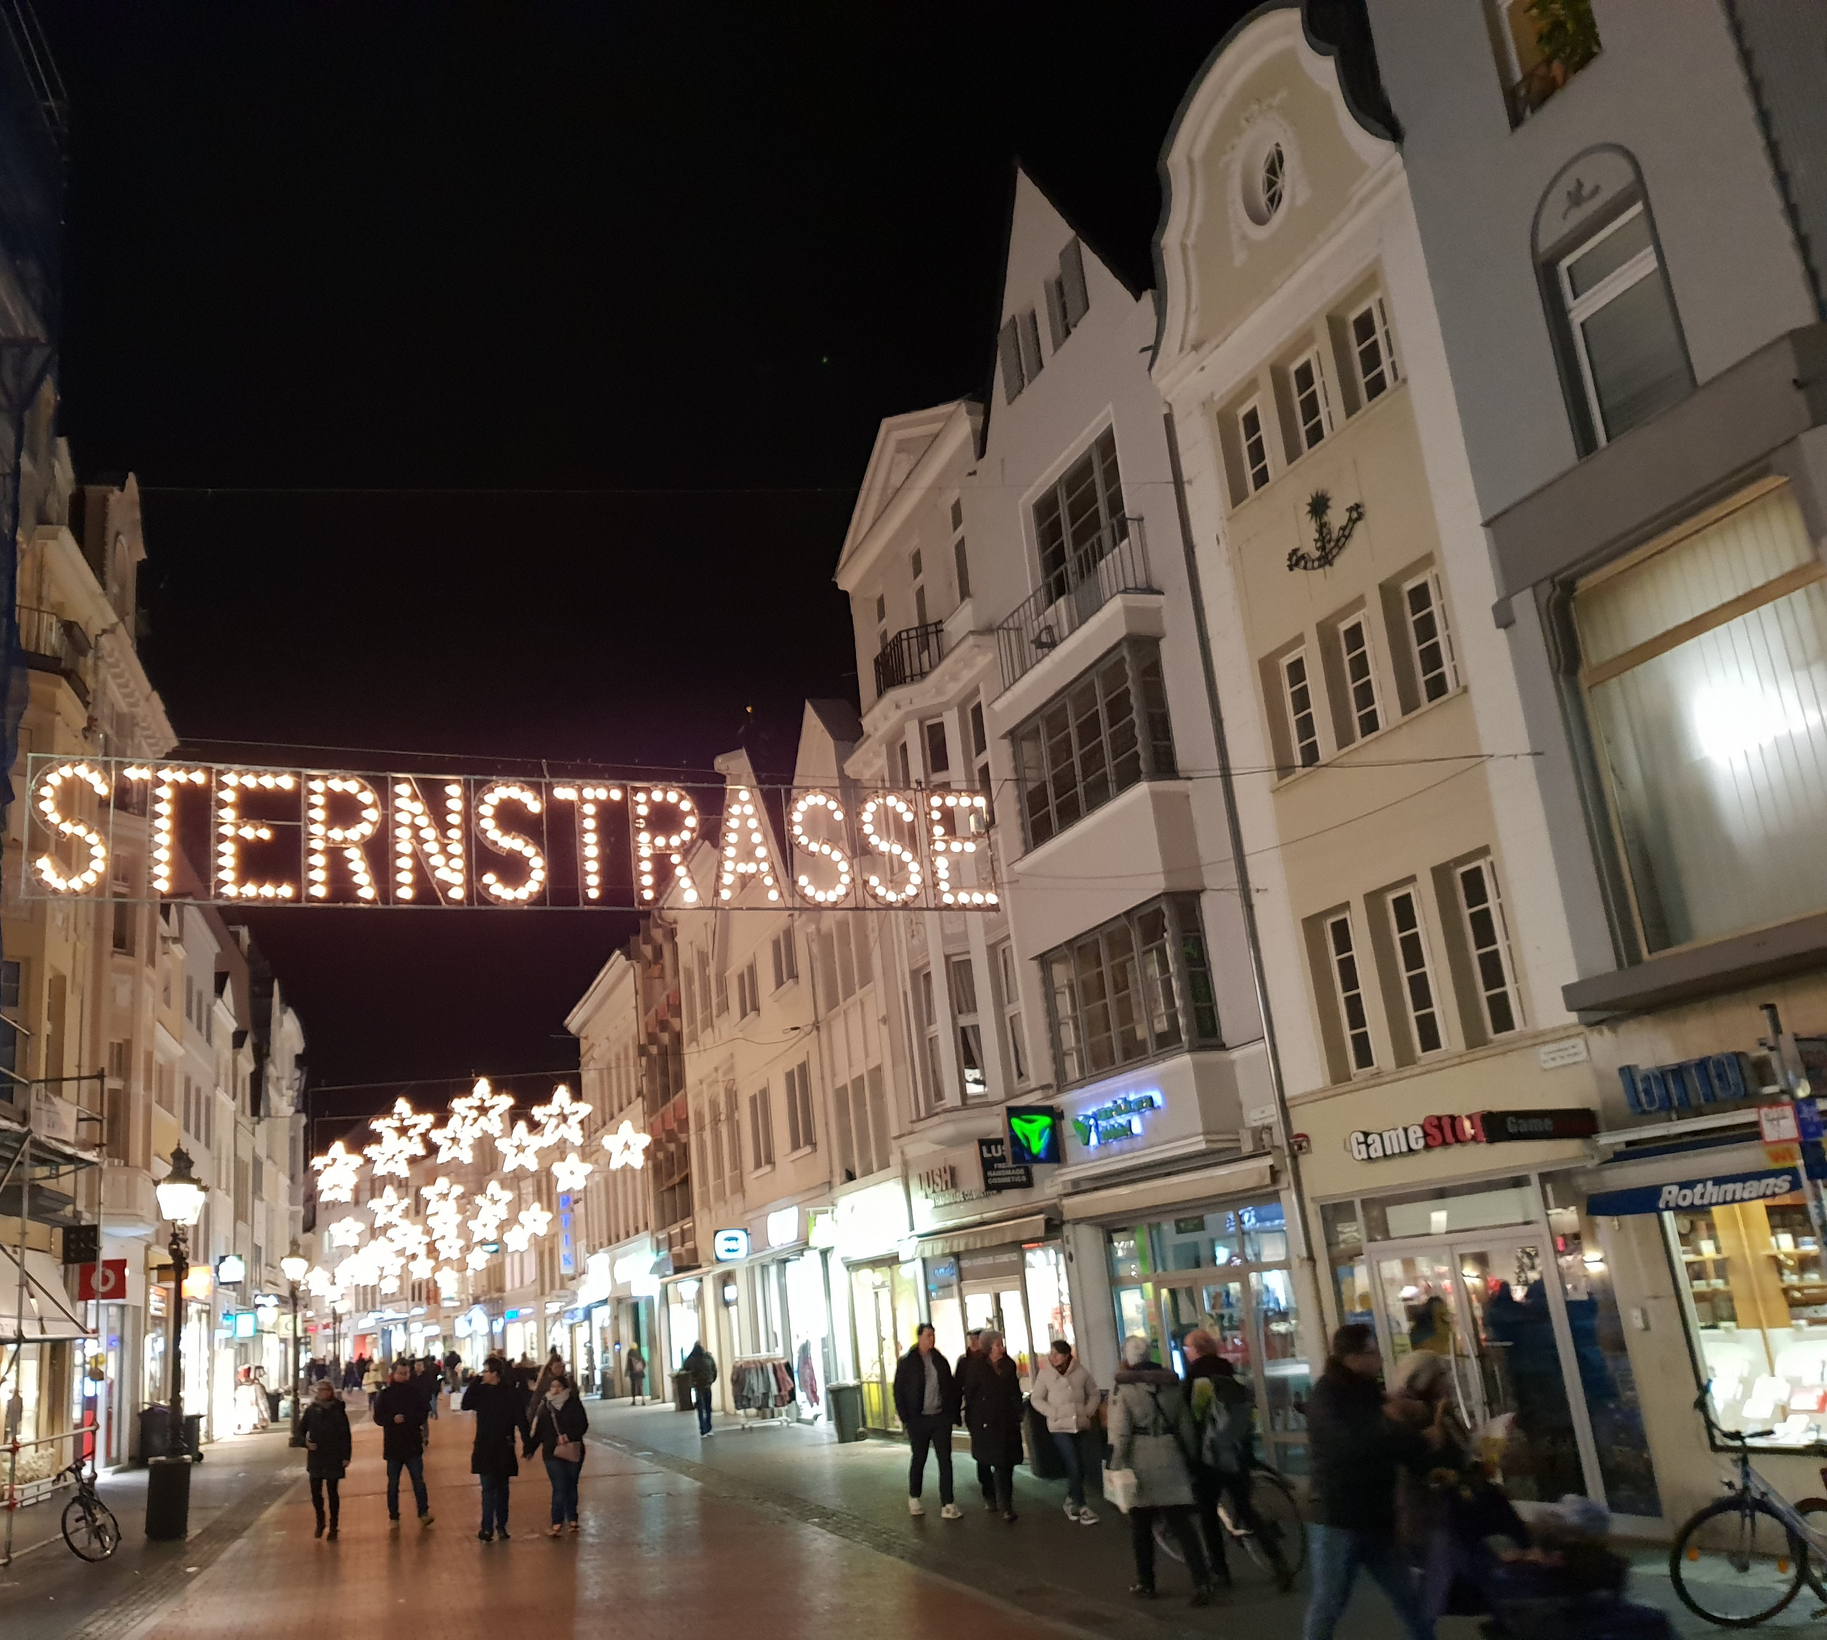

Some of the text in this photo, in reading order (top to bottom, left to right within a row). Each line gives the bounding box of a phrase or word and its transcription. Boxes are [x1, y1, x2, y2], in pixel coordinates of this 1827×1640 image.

[30, 760, 999, 906] STERNSTRASSE
[981, 1144, 1006, 1159] LU
[1658, 1174, 1793, 1209] Rothmans
[559, 1194, 573, 1266] PTIK
